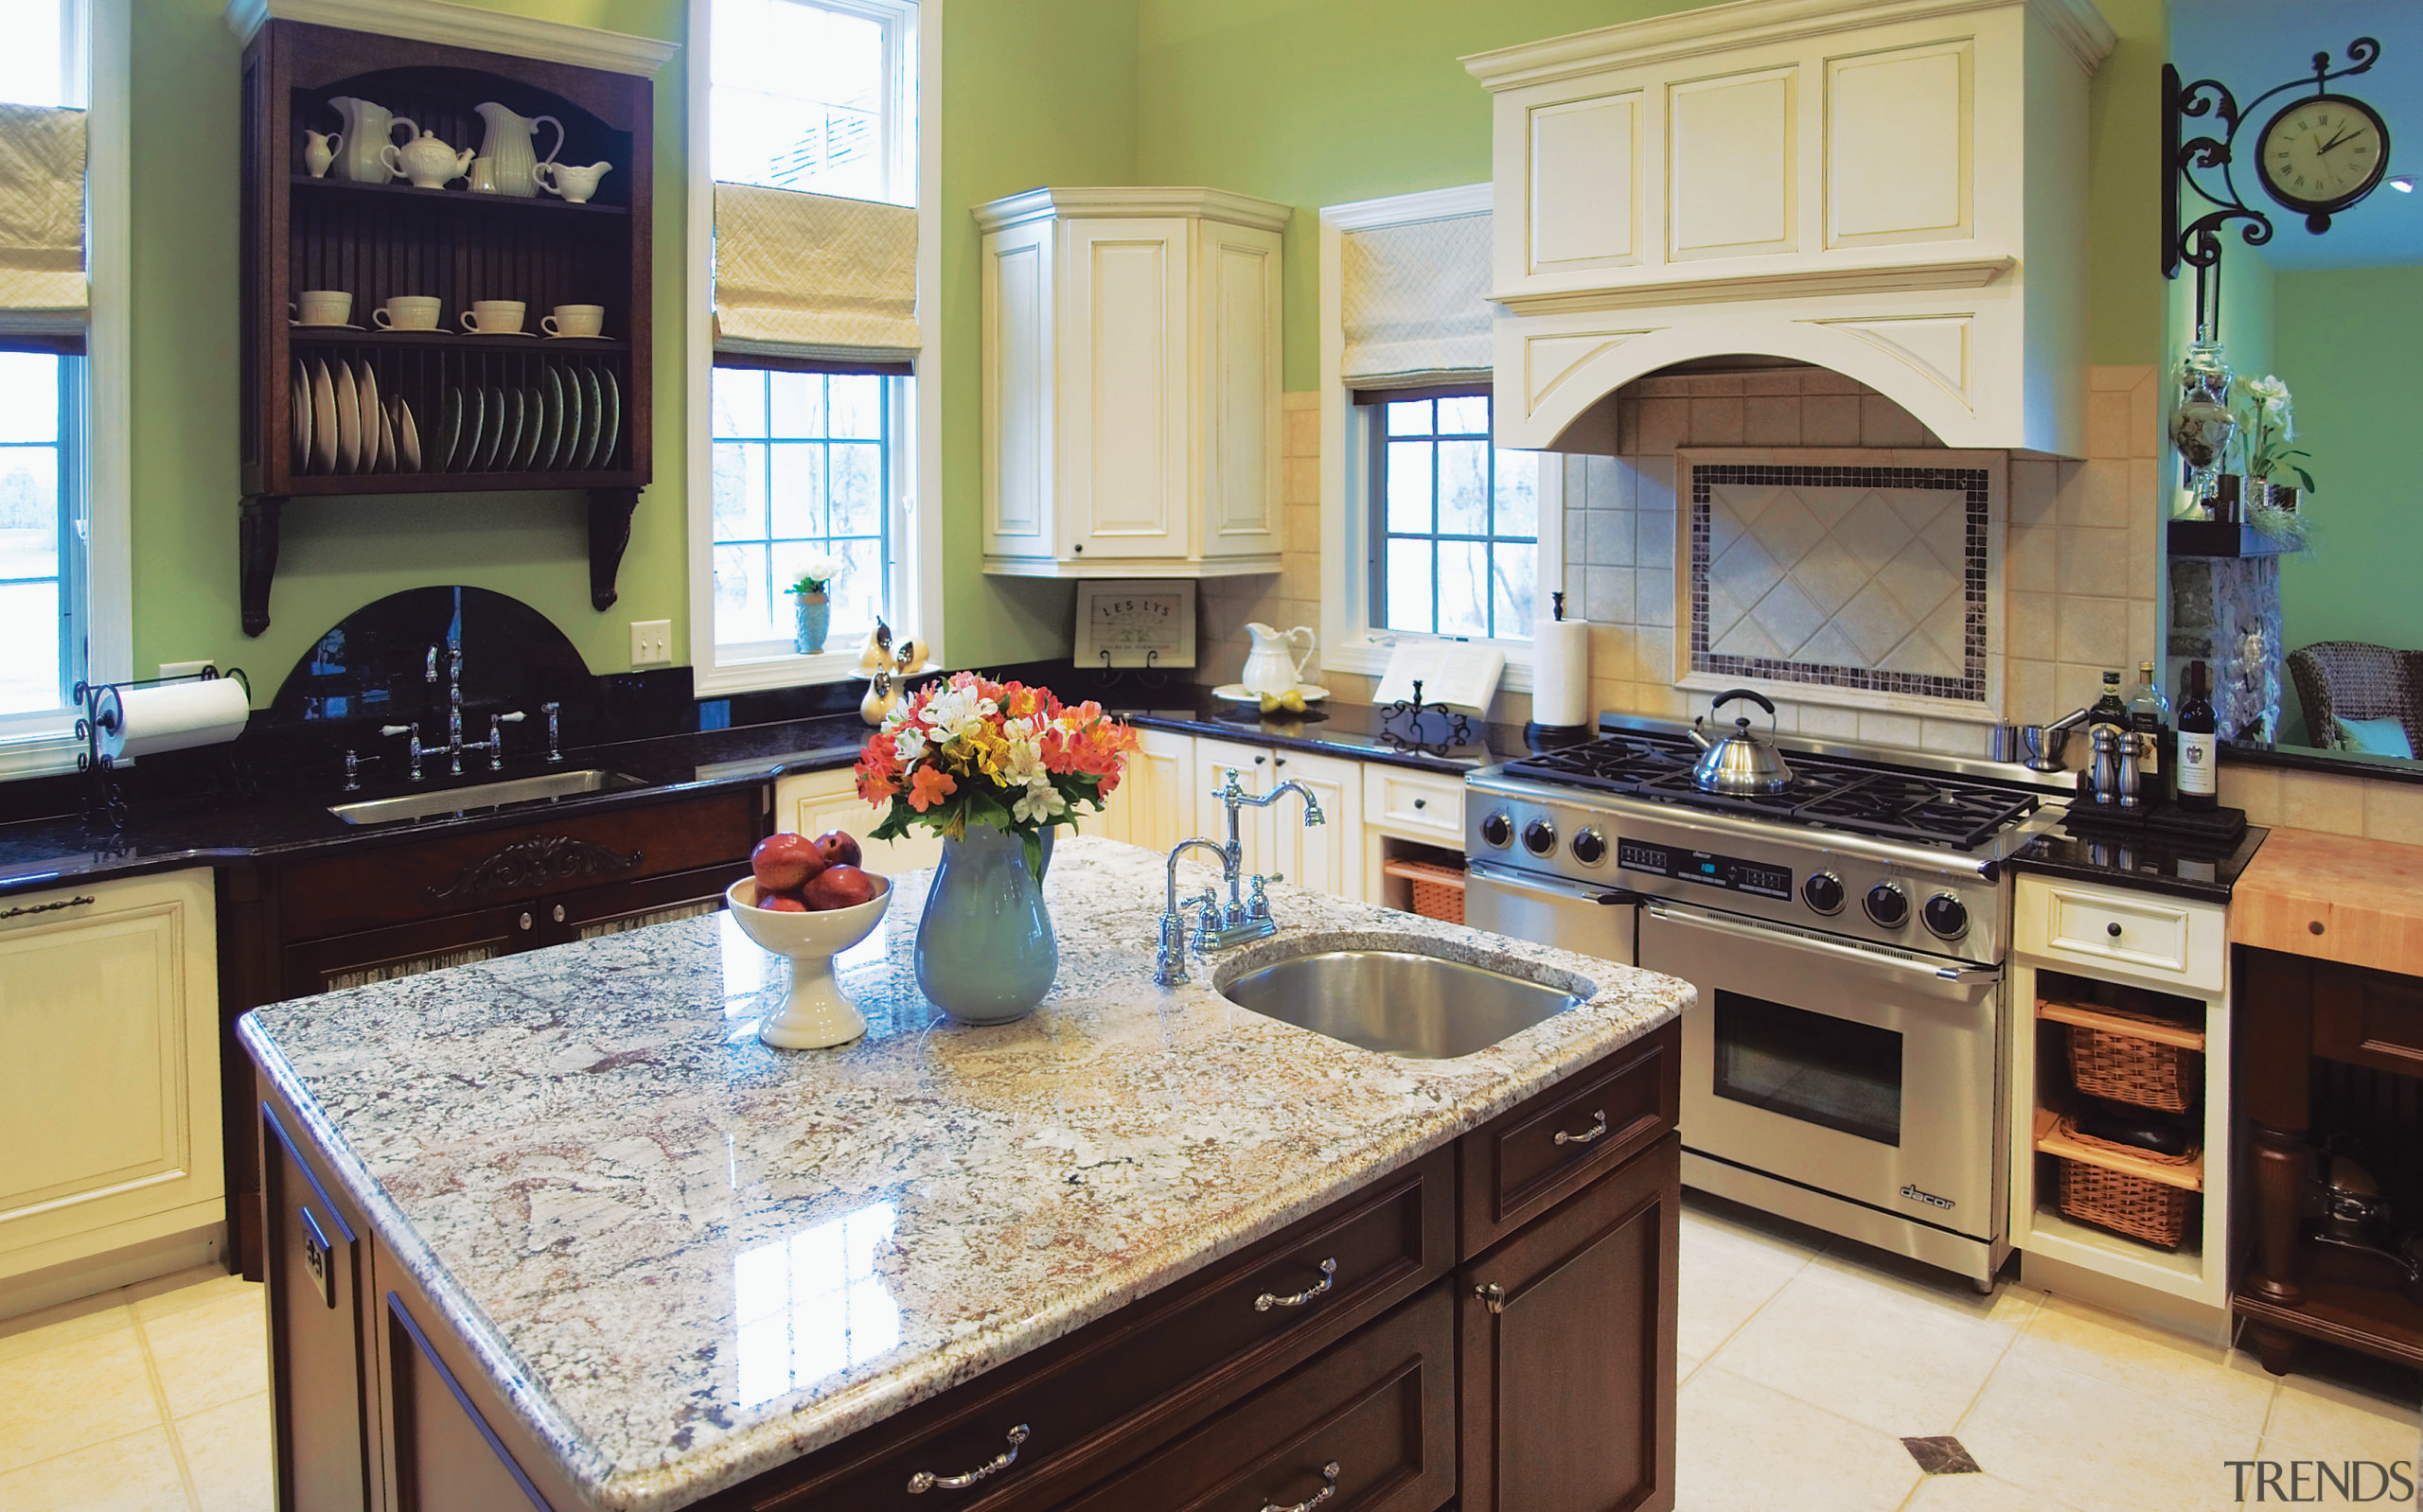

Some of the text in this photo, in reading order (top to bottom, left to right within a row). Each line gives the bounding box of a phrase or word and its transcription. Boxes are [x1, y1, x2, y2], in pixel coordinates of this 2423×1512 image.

[1103, 600, 1171, 617] LES LYS
[1900, 1184, 1955, 1209] dacor
